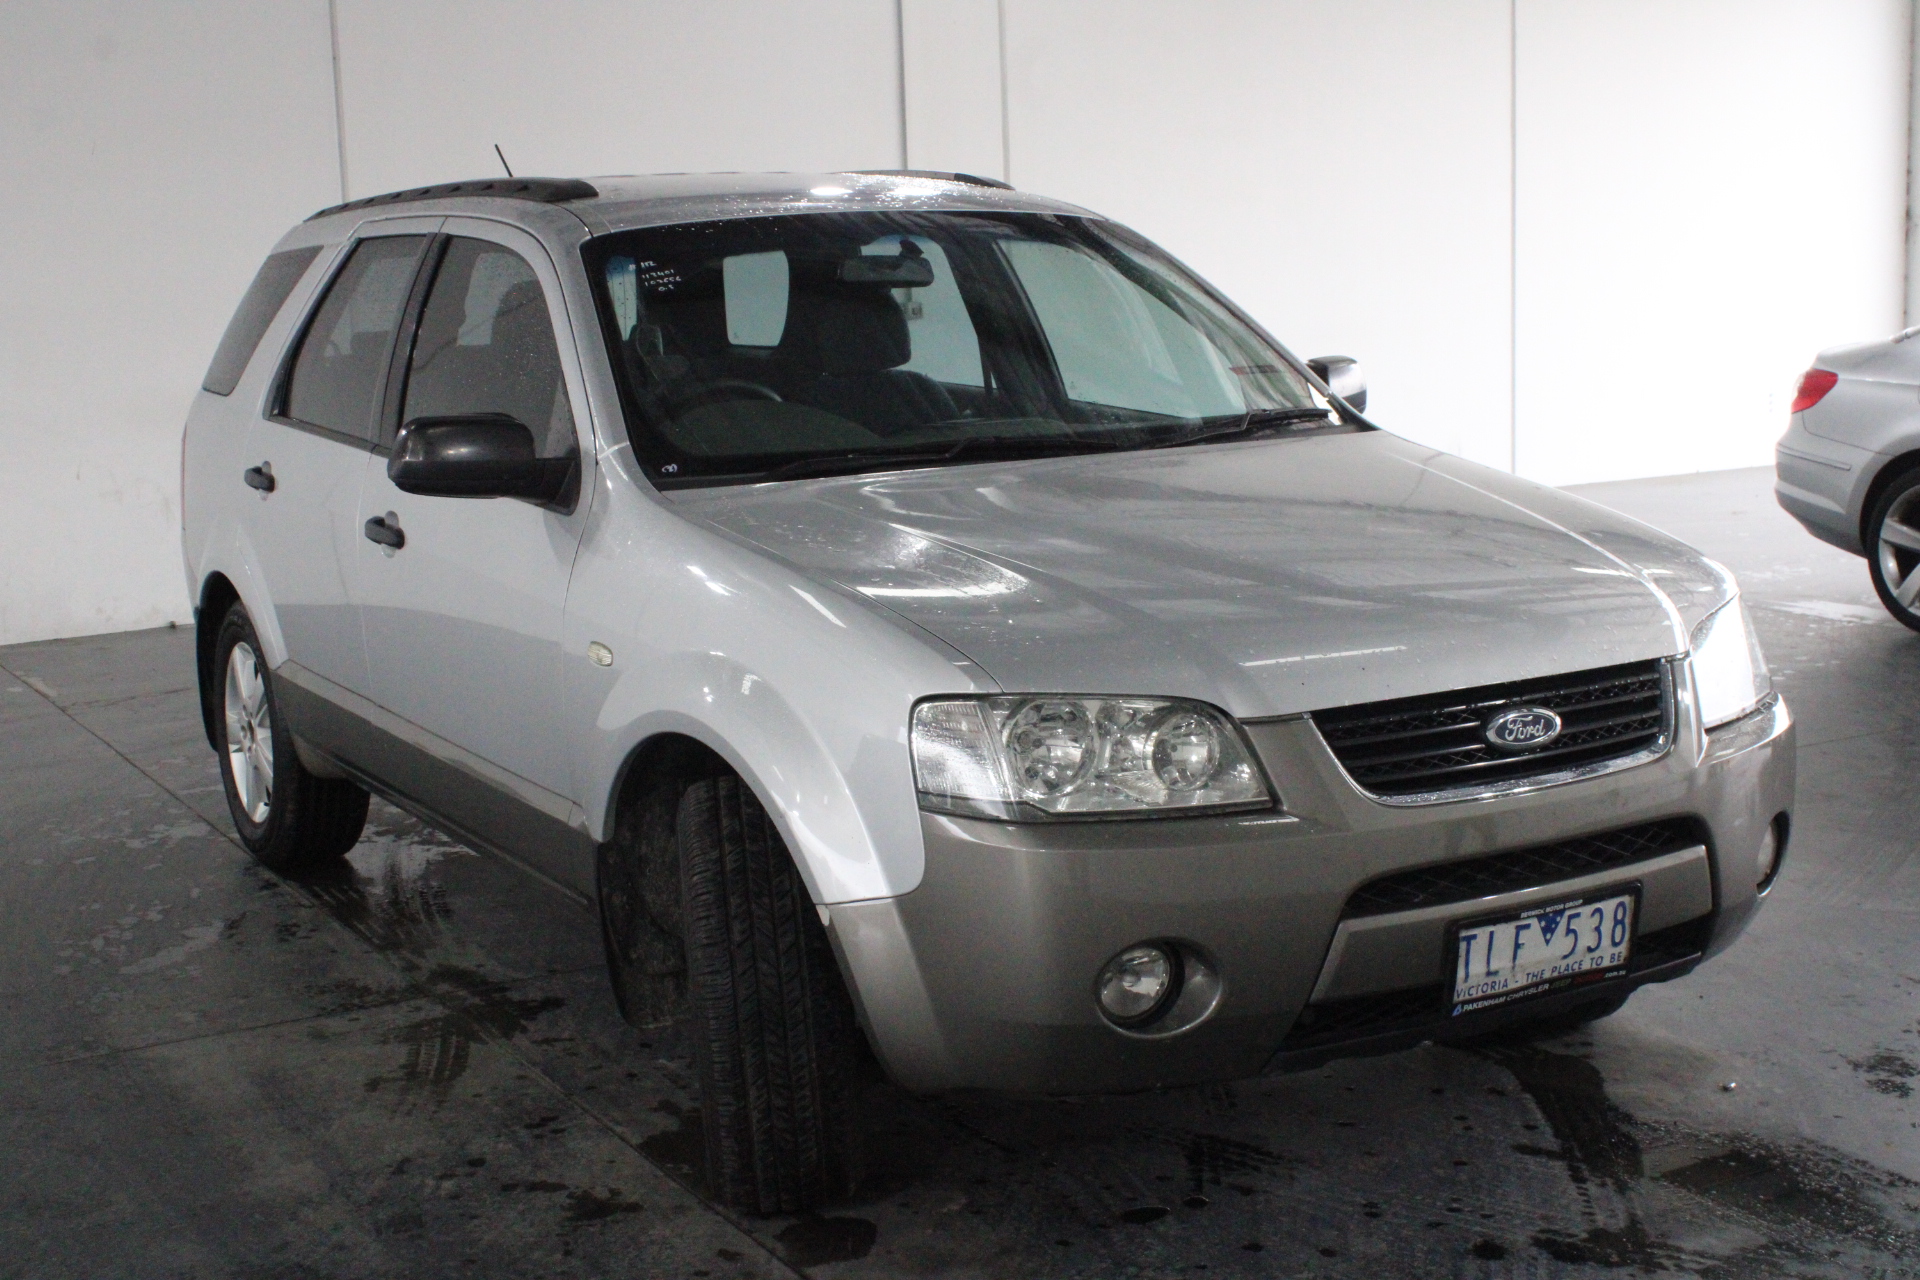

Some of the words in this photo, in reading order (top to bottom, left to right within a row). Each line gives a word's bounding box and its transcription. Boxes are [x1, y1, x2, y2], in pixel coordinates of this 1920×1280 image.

[1505, 715, 1546, 741] Ford
[1545, 903, 1565, 914] MOTOR
[1561, 901, 1627, 960] 538
[1455, 979, 1509, 999] VICTORIA
[1526, 969, 1545, 982] THE
[1550, 960, 1583, 977] PLACE
[1590, 955, 1603, 967] TO
[1610, 951, 1622, 963] BE
[1462, 996, 1506, 1012] PAKENHAM
[1507, 983, 1549, 1000] CHRYSLER
